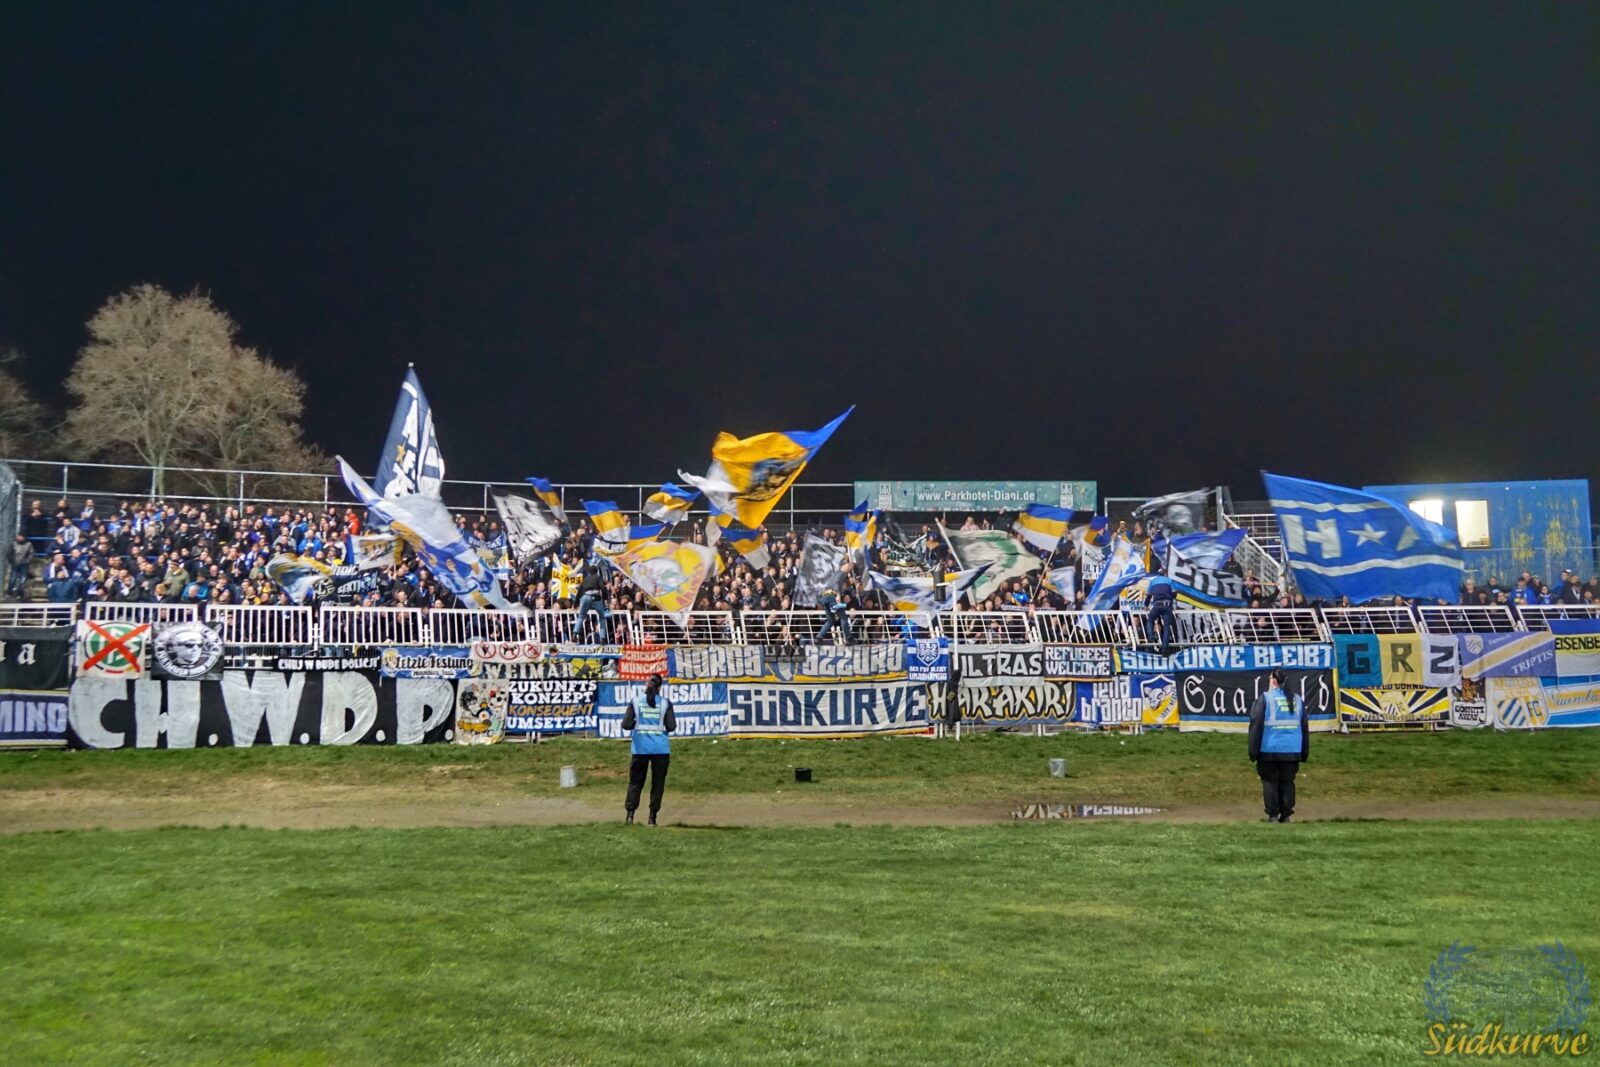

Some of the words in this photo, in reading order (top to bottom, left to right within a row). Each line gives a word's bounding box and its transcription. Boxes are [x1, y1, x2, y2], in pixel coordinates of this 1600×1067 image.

[917, 490, 1035, 502] www.Parkhotel-Diani.de
[1045, 647, 1110, 661] REFUGEES
[1254, 645, 1332, 668] BLEIBT
[429, 655, 474, 670] Festung
[1046, 661, 1110, 675] WELCOME
[1511, 650, 1554, 675] TRIPTIS
[509, 680, 597, 692] ZUKUNFTS
[511, 692, 593, 704] KONZEPT
[1184, 675, 1330, 713] Saalld
[509, 704, 594, 716] KONSEQUENT
[730, 686, 927, 726] SÜDKURVE
[507, 716, 598, 729] UMSETZEN
